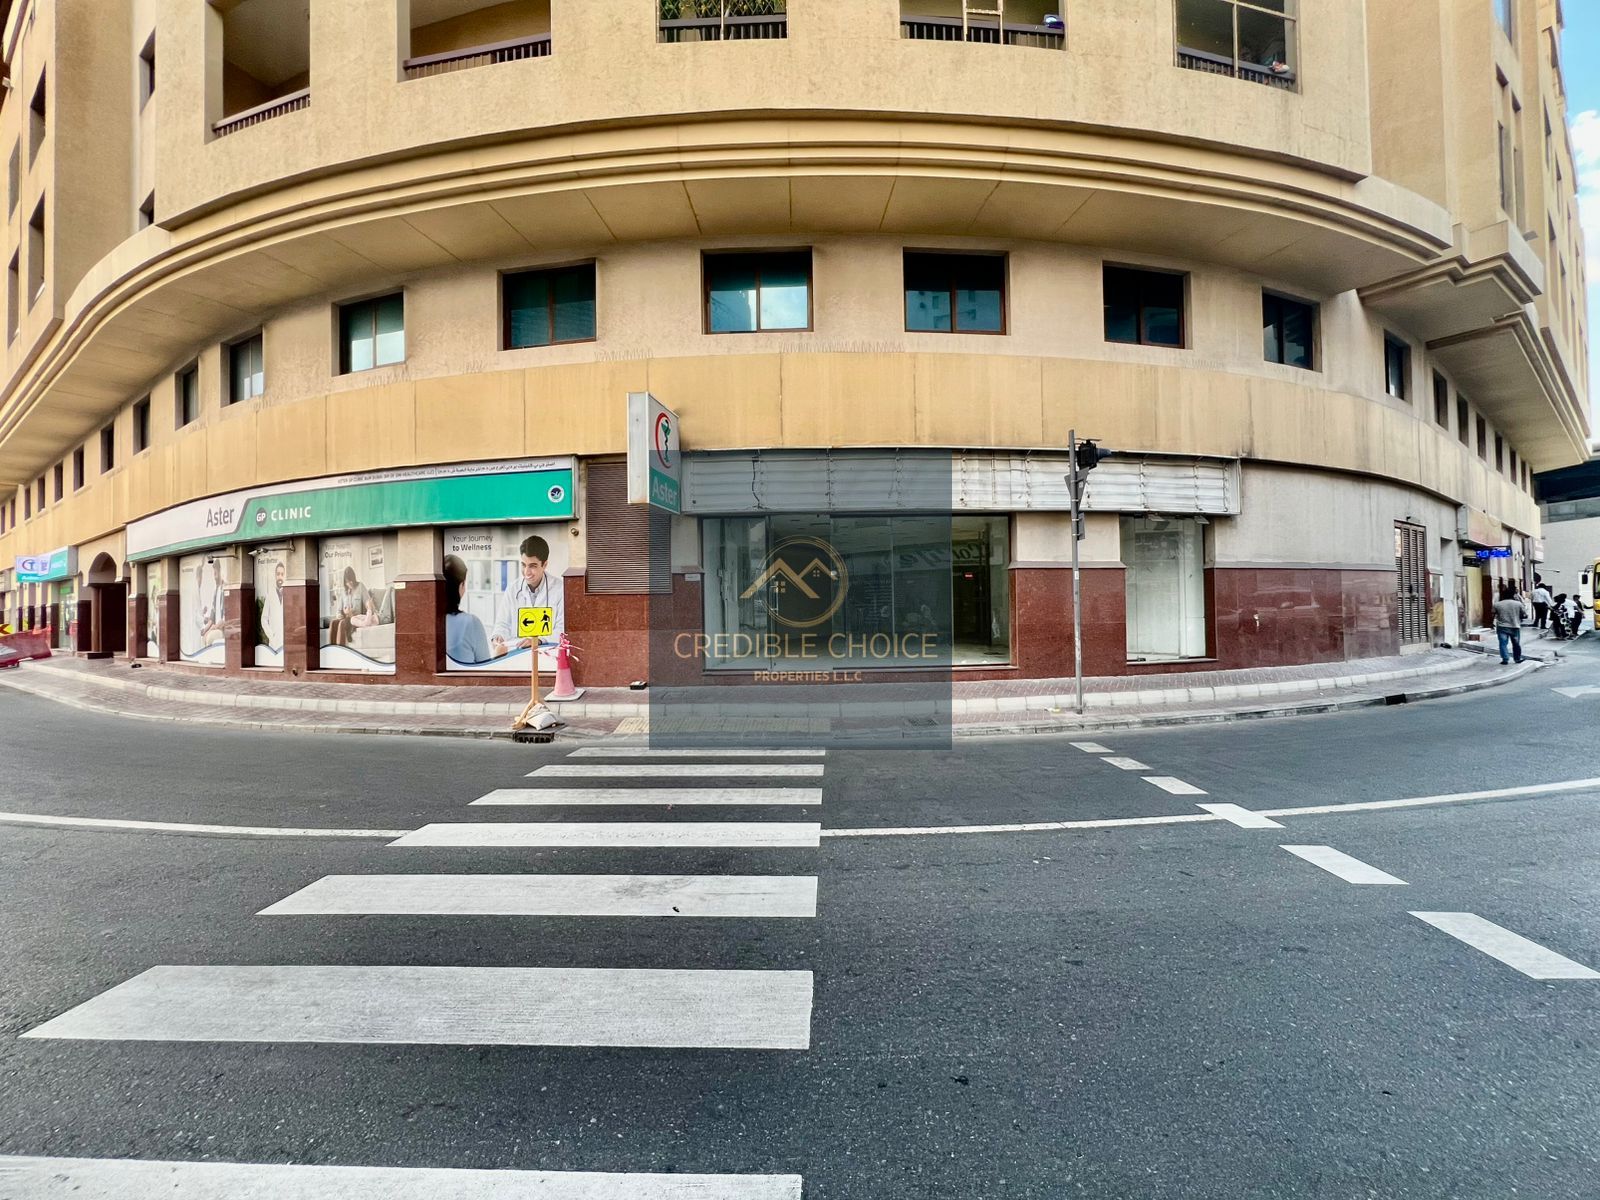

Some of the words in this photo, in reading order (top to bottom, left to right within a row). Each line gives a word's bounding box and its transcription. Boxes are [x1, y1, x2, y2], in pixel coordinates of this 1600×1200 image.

[652, 475, 678, 507] Aster
[206, 507, 235, 528] Aster
[256, 512, 266, 522] GP
[271, 506, 312, 521] CLINIC
[452, 535, 467, 543] Your
[468, 535, 494, 543] Journey
